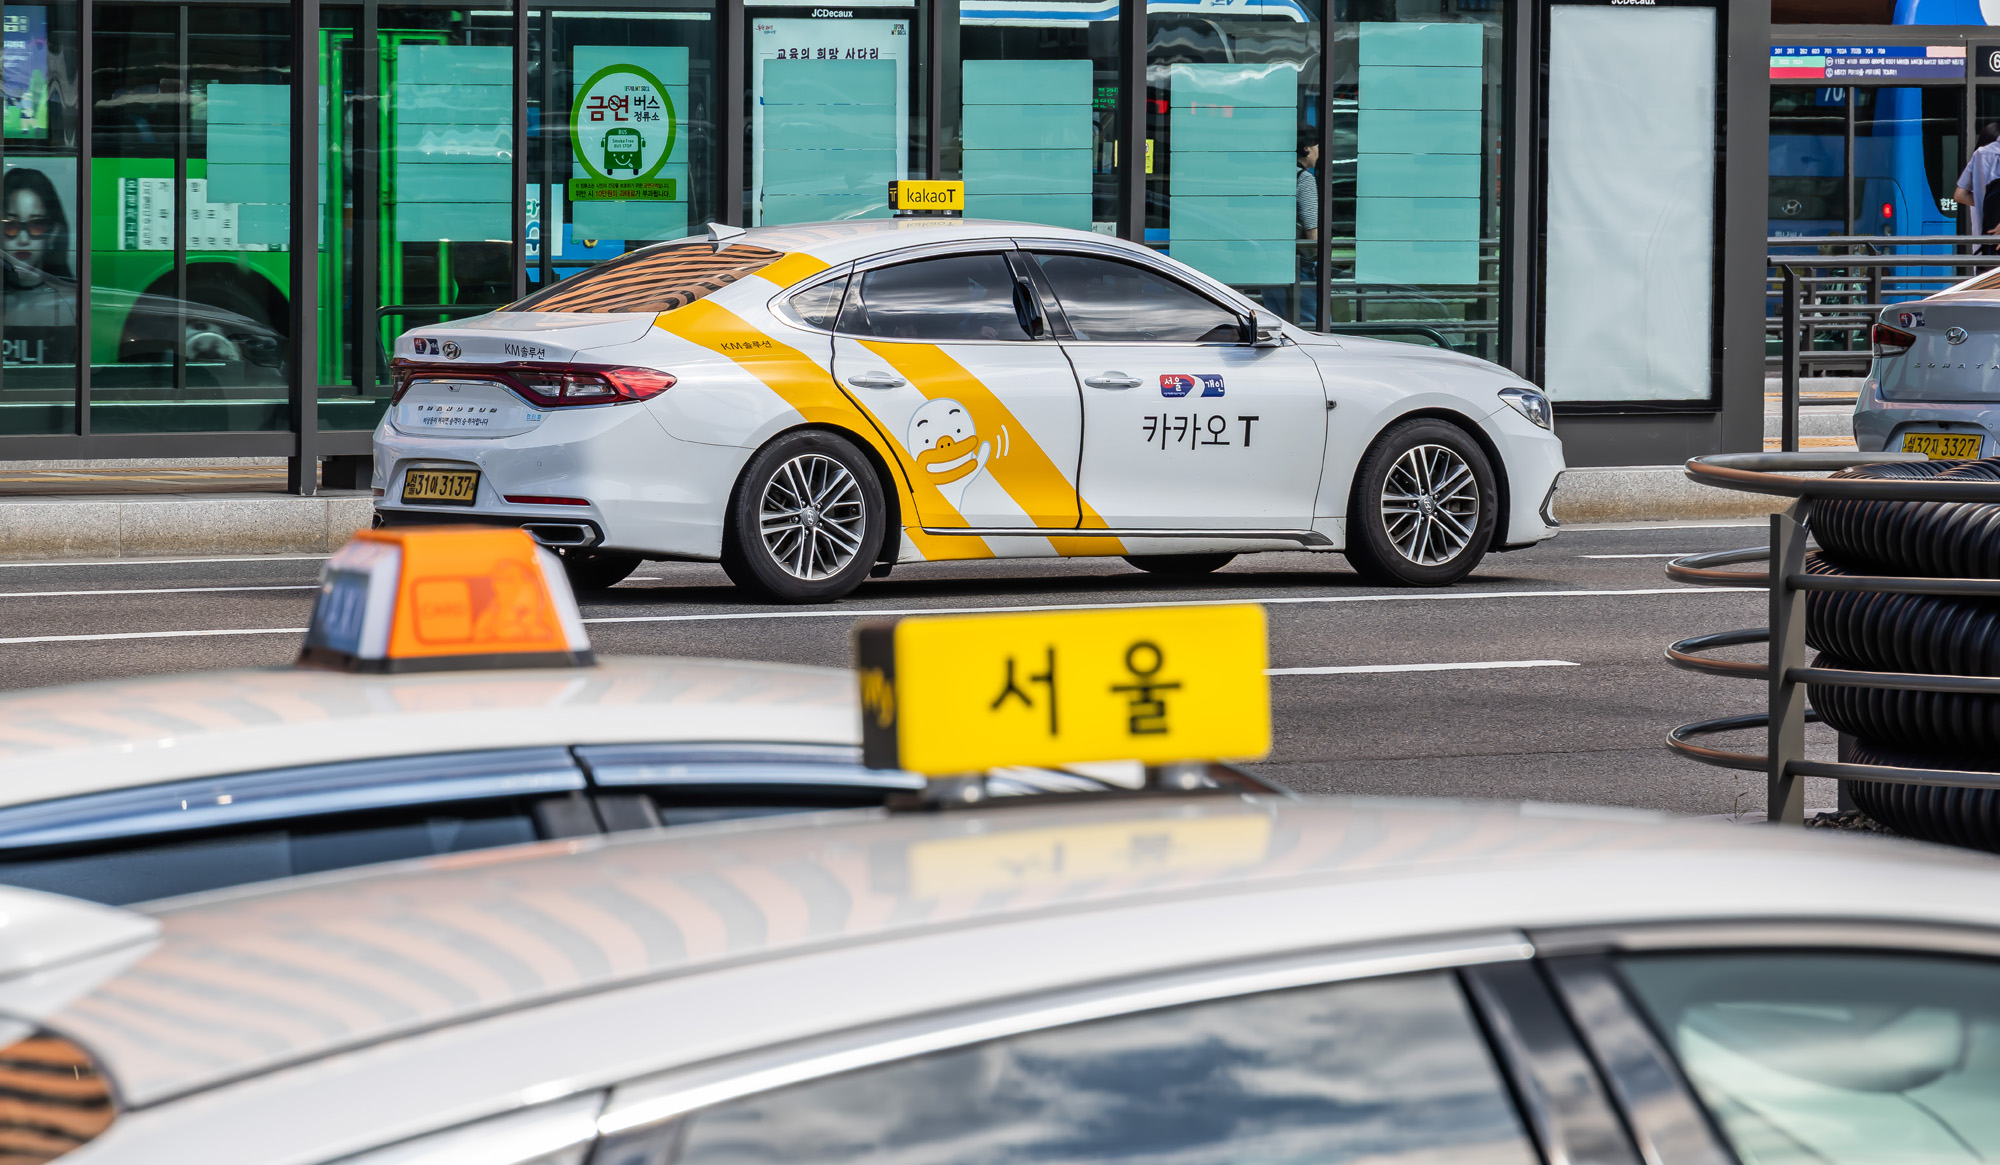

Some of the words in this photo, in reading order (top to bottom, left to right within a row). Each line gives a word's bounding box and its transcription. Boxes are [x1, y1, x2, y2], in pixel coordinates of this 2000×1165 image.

[811, 9, 853, 18] JCDecaux
[817, 48, 839, 59] 희망
[846, 48, 879, 59] 사다리
[586, 95, 629, 121] 금연
[634, 95, 660, 110] 버스
[634, 112, 660, 122] 정류소
[907, 188, 956, 203] kakaoT
[505, 343, 545, 360] KM솔루션
[1164, 376, 1182, 392] 서울
[1205, 379, 1224, 392] 개인
[1143, 413, 1230, 450] 카카오
[1238, 416, 1259, 447] T
[1941, 438, 1977, 457] 3327
[440, 476, 472, 496] 3137
[989, 641, 1183, 737] 서울
